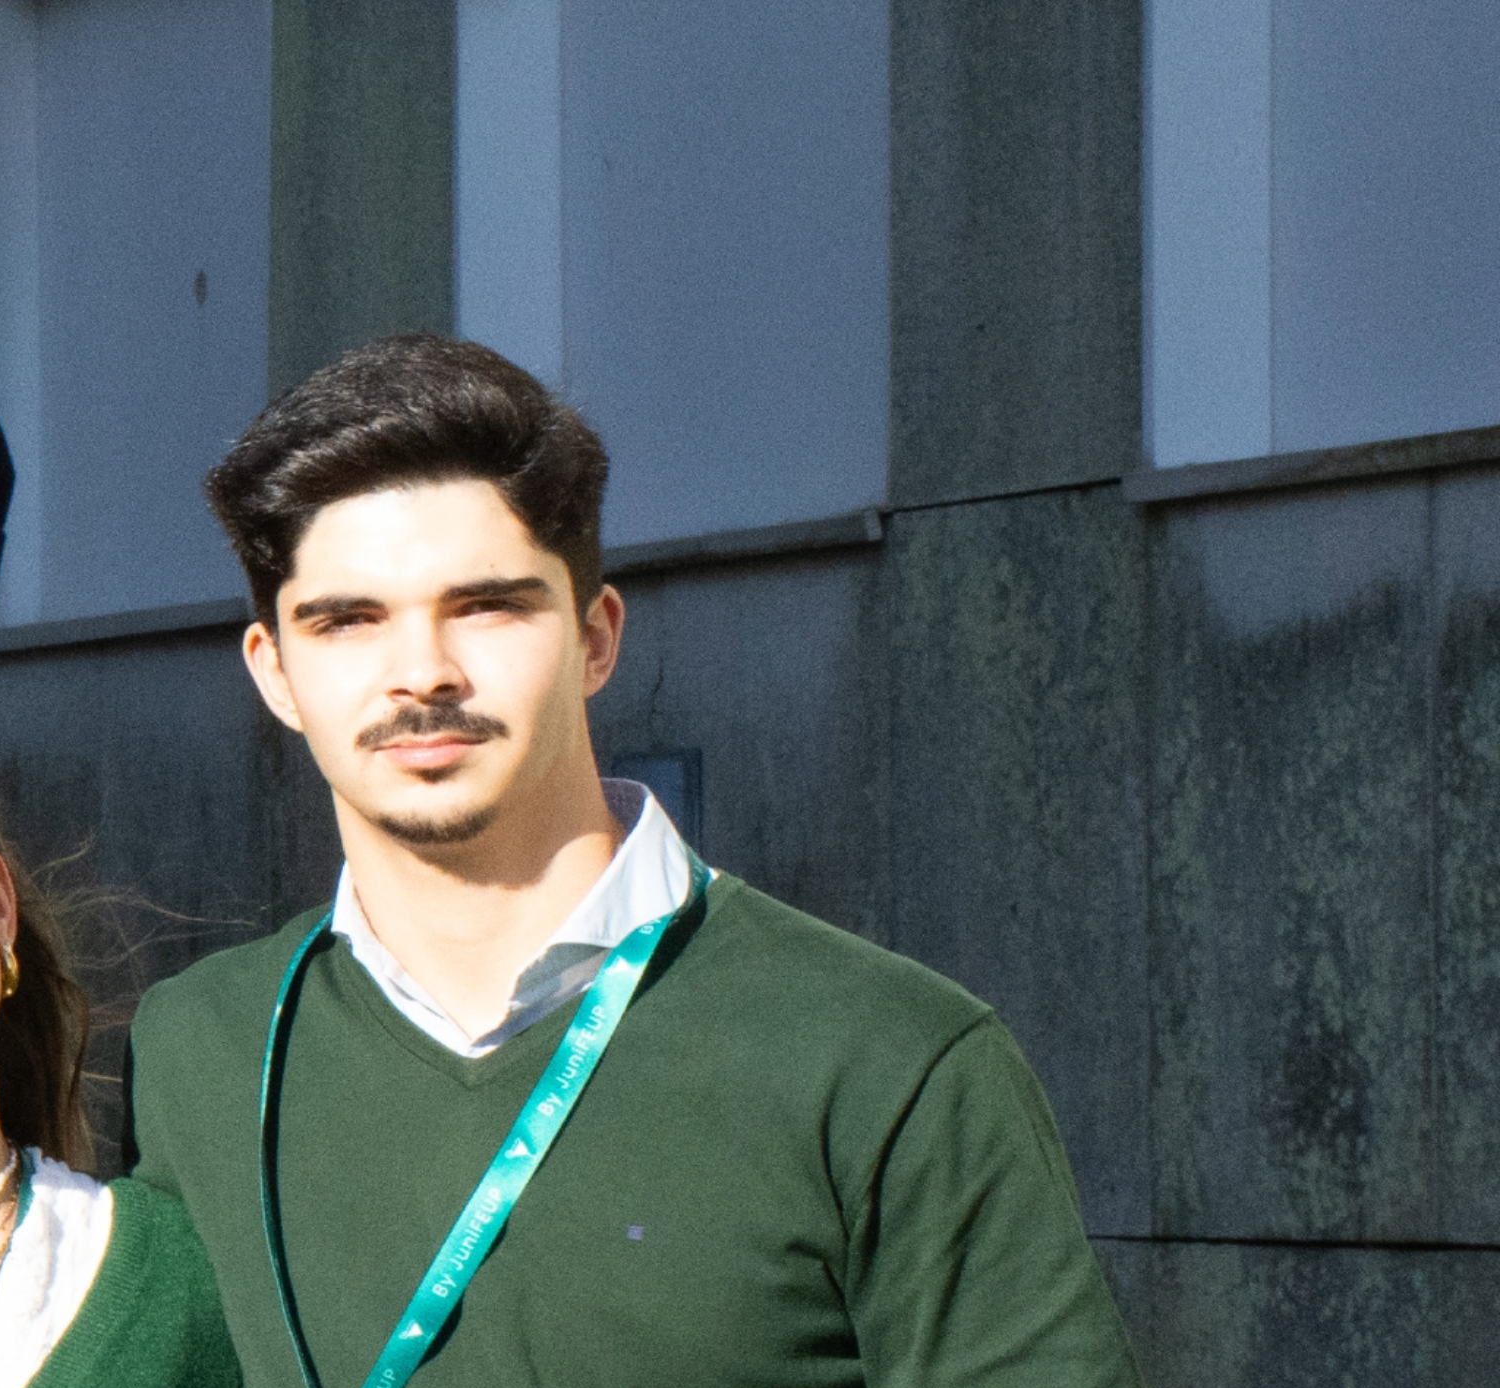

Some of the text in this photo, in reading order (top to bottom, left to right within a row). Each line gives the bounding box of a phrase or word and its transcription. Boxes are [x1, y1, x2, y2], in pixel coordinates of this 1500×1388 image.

[537, 1004, 607, 1116] By JuniFEUP
[432, 1186, 502, 1299] By JuniFEUP
